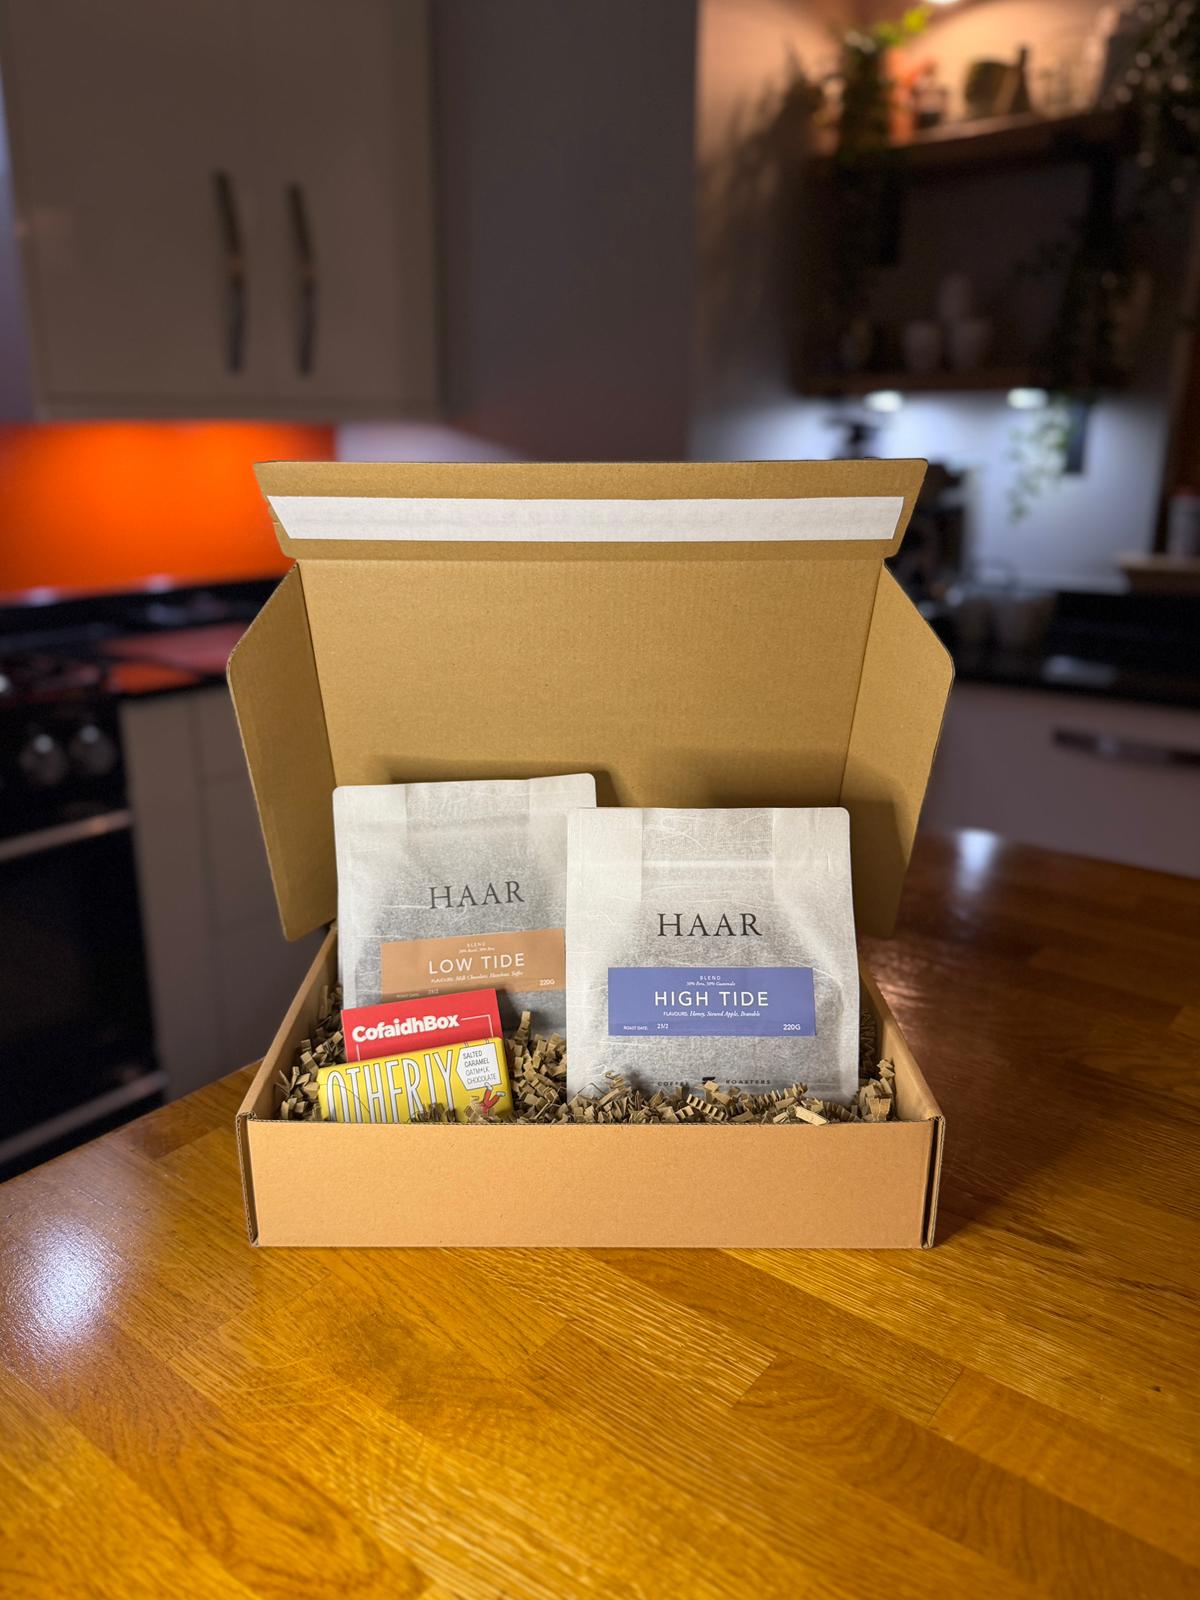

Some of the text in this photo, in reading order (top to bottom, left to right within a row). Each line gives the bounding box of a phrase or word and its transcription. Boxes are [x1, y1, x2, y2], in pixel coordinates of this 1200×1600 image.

[428, 880, 525, 910] HAAR
[657, 912, 763, 937] HAAR
[428, 952, 525, 975] LOW TIDE
[654, 991, 769, 1006] HIGH TIDE
[351, 1014, 461, 1043] CofaidhBox
[783, 1023, 801, 1031] 220G
[462, 1050, 483, 1060] SALTED
[464, 1057, 490, 1068] CARAMEL
[467, 1072, 496, 1085] CHOCOLATE
